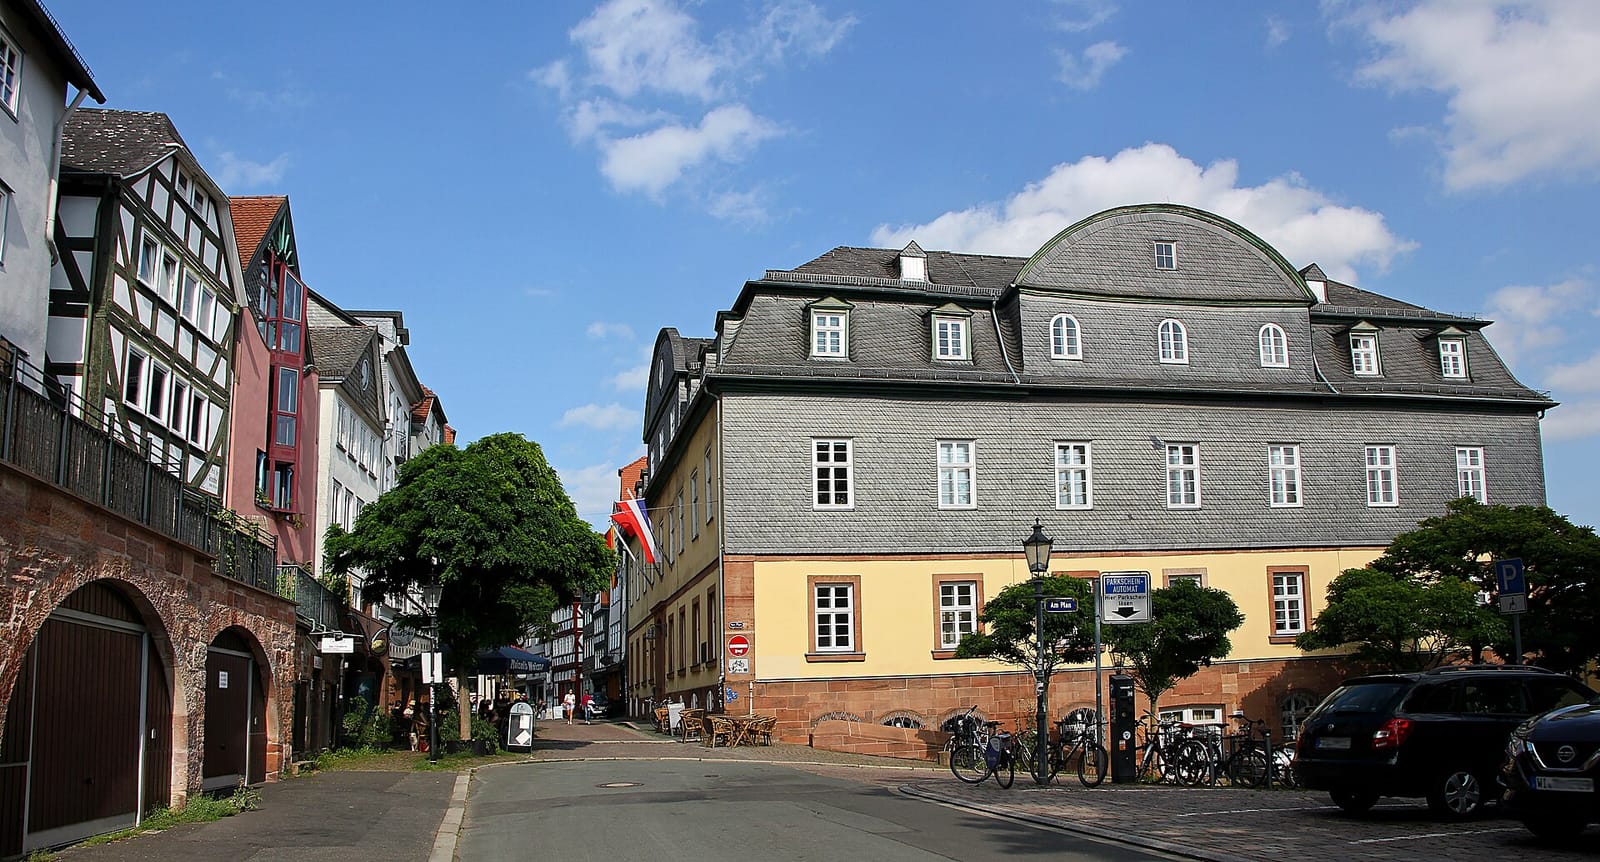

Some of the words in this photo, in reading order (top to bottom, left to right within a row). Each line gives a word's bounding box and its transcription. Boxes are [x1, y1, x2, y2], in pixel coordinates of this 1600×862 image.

[1106, 577, 1144, 586] PARKSCHEIN-
[1112, 585, 1138, 593] AUTOMAT
[1060, 601, 1071, 609] Plan
